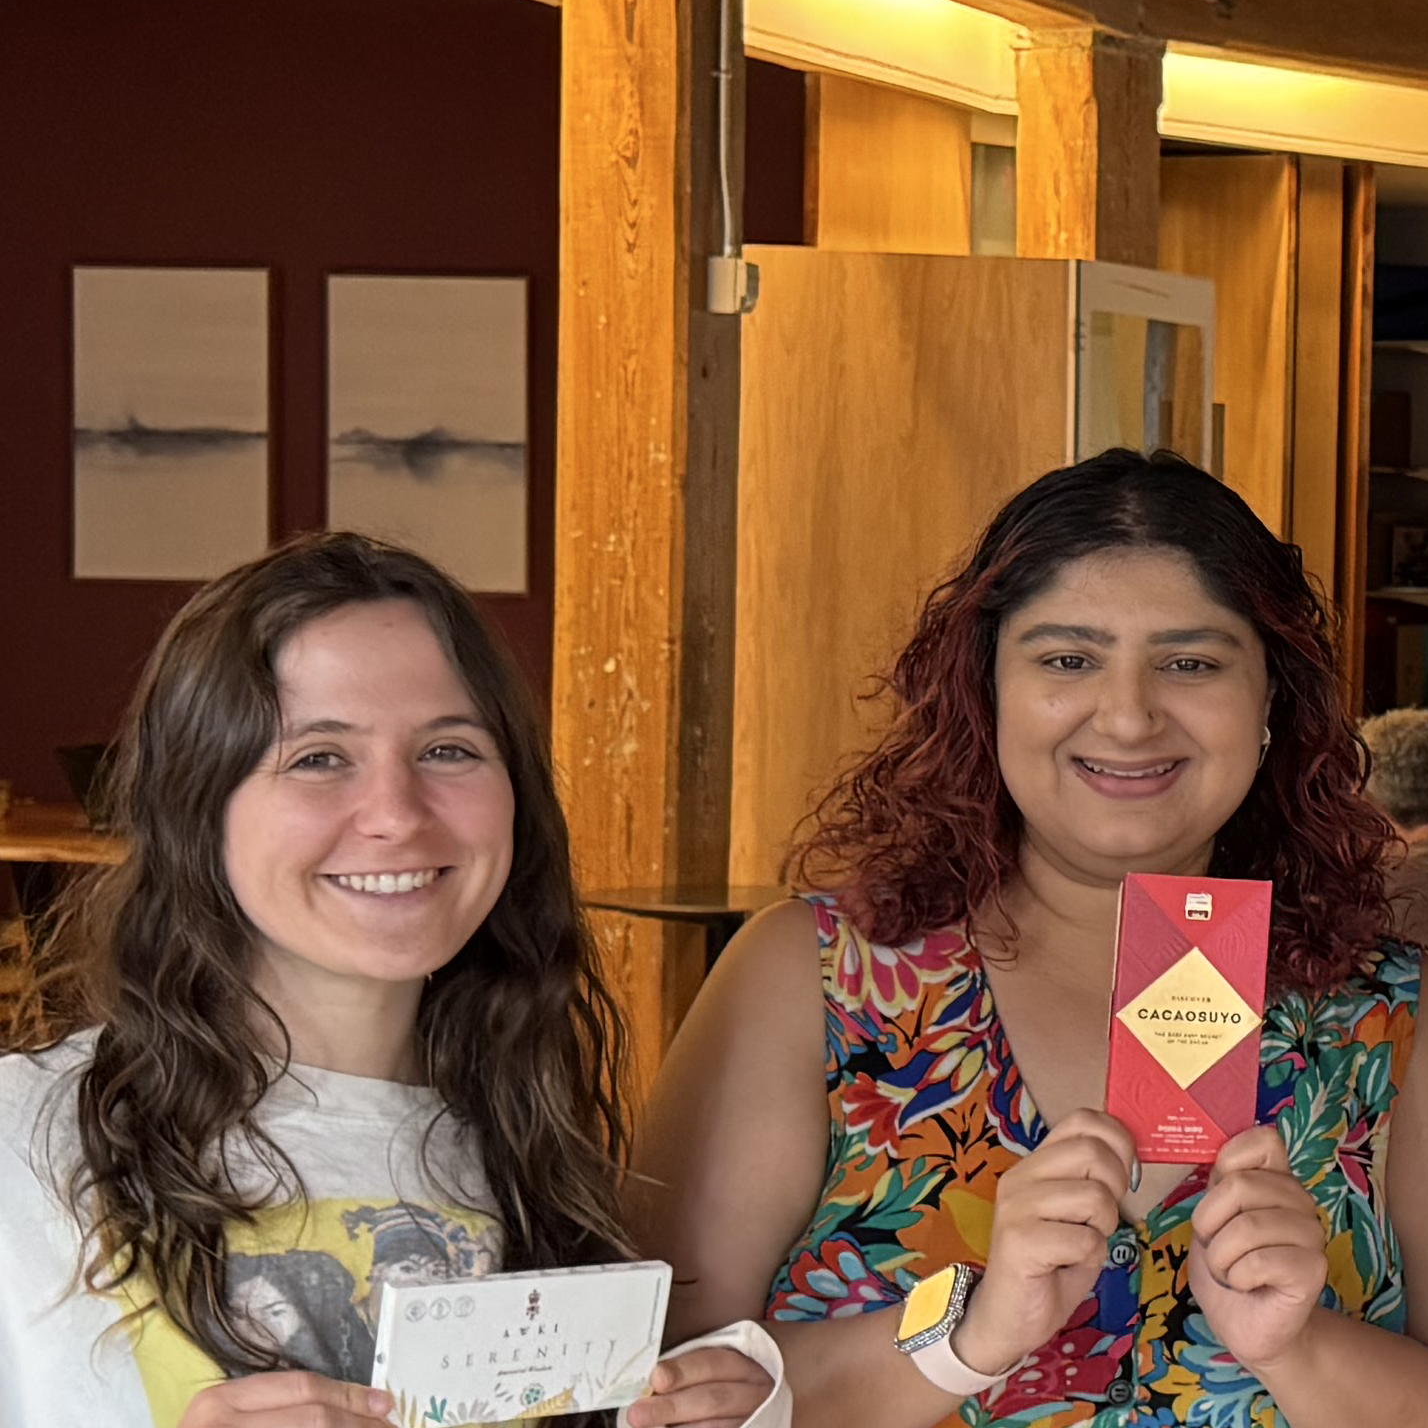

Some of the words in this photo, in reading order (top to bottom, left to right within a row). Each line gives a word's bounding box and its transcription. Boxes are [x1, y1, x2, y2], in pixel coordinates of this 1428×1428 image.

[1137, 1008, 1242, 1025] CACAOSUYO
[503, 1323, 559, 1339] AWKI
[440, 1339, 619, 1370] SERENITY
